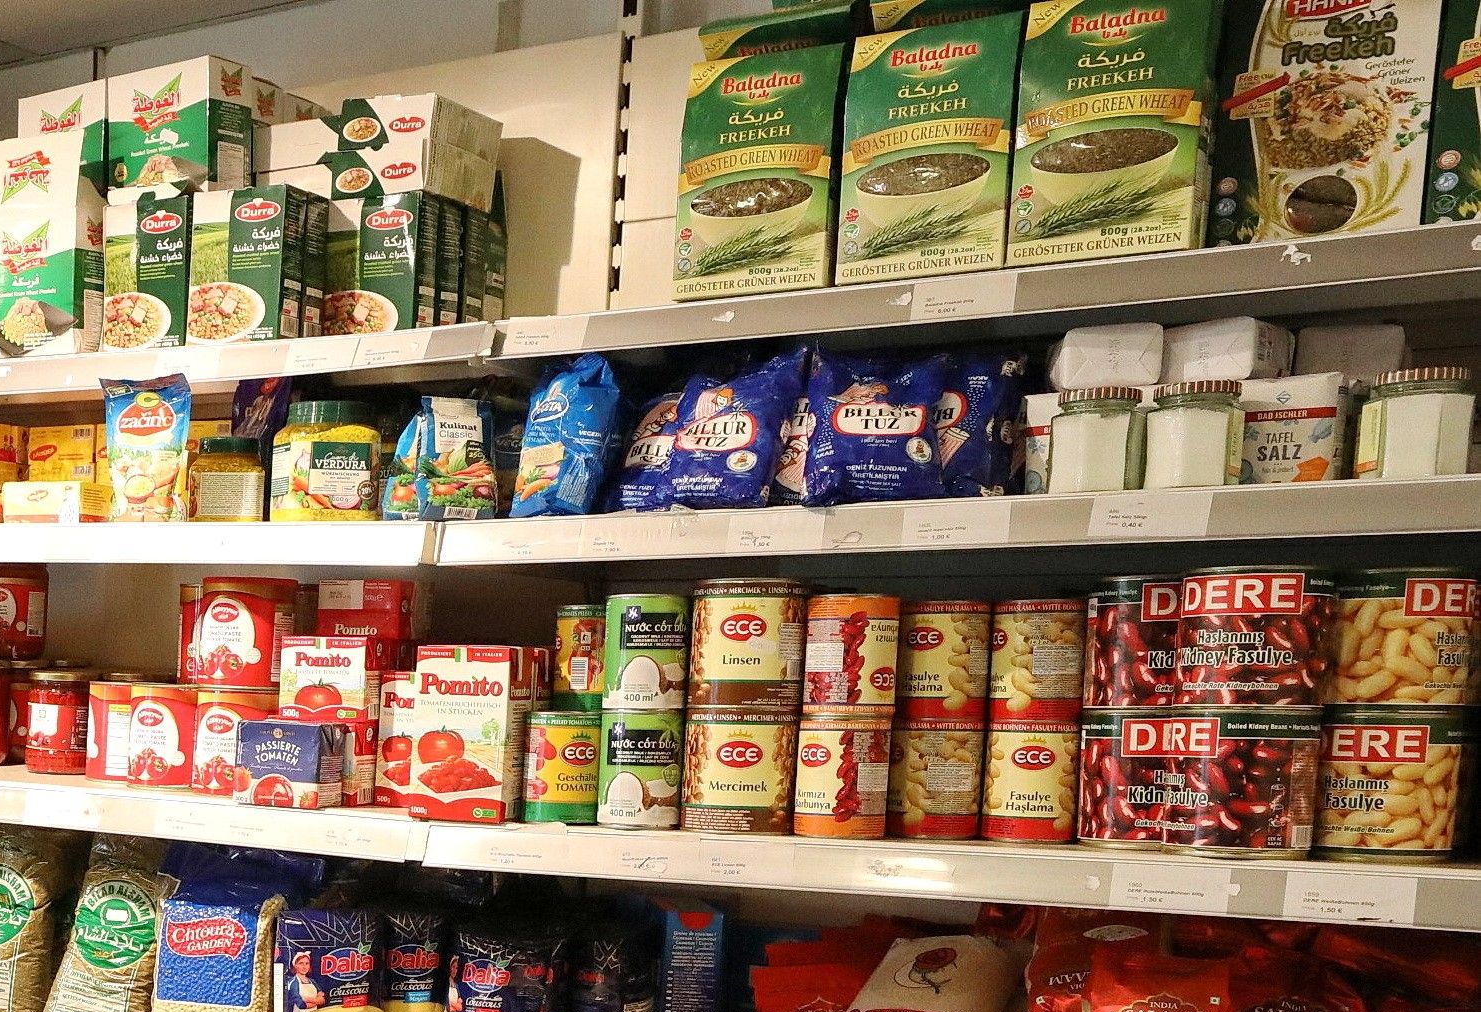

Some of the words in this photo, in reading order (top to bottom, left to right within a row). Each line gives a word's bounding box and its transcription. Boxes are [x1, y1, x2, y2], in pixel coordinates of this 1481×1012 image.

[1069, 5, 1166, 35] Baladna
[1324, 12, 1398, 38] فريكة
[890, 41, 977, 71] Baladna
[1281, 35, 1396, 65] Freekeh
[1077, 49, 1146, 69] فريكة
[1365, 57, 1415, 69] Gerösteter
[1378, 67, 1411, 78] Grüner
[721, 71, 802, 98] Baladna
[1067, 68, 1154, 92] FREEKEH
[1390, 76, 1425, 85] Weizen
[898, 80, 960, 99] فريكة
[889, 97, 968, 119] FREEKEH
[1091, 96, 1138, 116] GREEN
[1139, 91, 1185, 110] WHEAT
[728, 108, 785, 126] فريكة
[392, 120, 422, 130] Durra
[911, 124, 953, 143] GREEN
[954, 120, 996, 137] WHEAT
[719, 125, 791, 144] FREEKEH
[739, 152, 776, 166] GREEN
[778, 149, 821, 164] WHEAT
[384, 166, 413, 175] Durra
[240, 205, 275, 217] Durra
[145, 218, 177, 229] Durra
[370, 215, 406, 226] Durra
[252, 227, 281, 240] فريكة
[1100, 225, 1128, 236] 800g
[157, 238, 183, 251] فريكة
[1013, 241, 1084, 258] GERÖSTETER
[1086, 236, 1133, 250] GRÜNER
[1136, 231, 1181, 246] WEIZEN
[919, 247, 946, 258] 800g
[748, 267, 772, 276] 800g
[842, 264, 910, 277] GERÖSTETER
[913, 258, 955, 272] GRÜNER
[958, 253, 995, 267] WEIZEN
[676, 279, 735, 294] GERÖSTETER
[736, 275, 778, 287] GRÜNER
[779, 272, 816, 284] WEIZEN
[439, 422, 478, 432] Kulinat
[861, 418, 899, 429] TUZ
[439, 429, 474, 441] Classic
[694, 435, 727, 447] TUZ
[1266, 432, 1295, 444] TAFEL
[1256, 444, 1302, 461] SALZ
[315, 459, 367, 470] VERDURA
[1184, 578, 1296, 611] DERE
[724, 621, 762, 634] ECE
[1198, 630, 1264, 645] Haşlanmış
[723, 654, 760, 665] Linsen
[1181, 649, 1223, 669] Kidney
[1227, 648, 1293, 666] Fasulye
[642, 693, 653, 701] ml
[255, 740, 302, 756] PASSIERTE
[1332, 729, 1422, 758] ERE
[564, 746, 595, 759] ECE
[720, 747, 759, 760] ECE
[1014, 750, 1053, 764] ECE
[254, 753, 299, 766] TOMATEN
[556, 783, 598, 792] TOMATEN
[709, 780, 767, 792] Mercimek
[1325, 777, 1389, 793] Haşlanmış
[1010, 790, 1051, 802] Fasulye
[1325, 794, 1384, 811] Fasulye
[627, 808, 636, 816] ml
[1006, 801, 1054, 813] Haşlama
[171, 923, 241, 946] Chtoura
[187, 938, 232, 951] GARDEN
[320, 952, 374, 974] Dalia
[389, 948, 439, 970] Dalia
[461, 961, 509, 986] Dalia
[1150, 1001, 1178, 1010] INDIA
